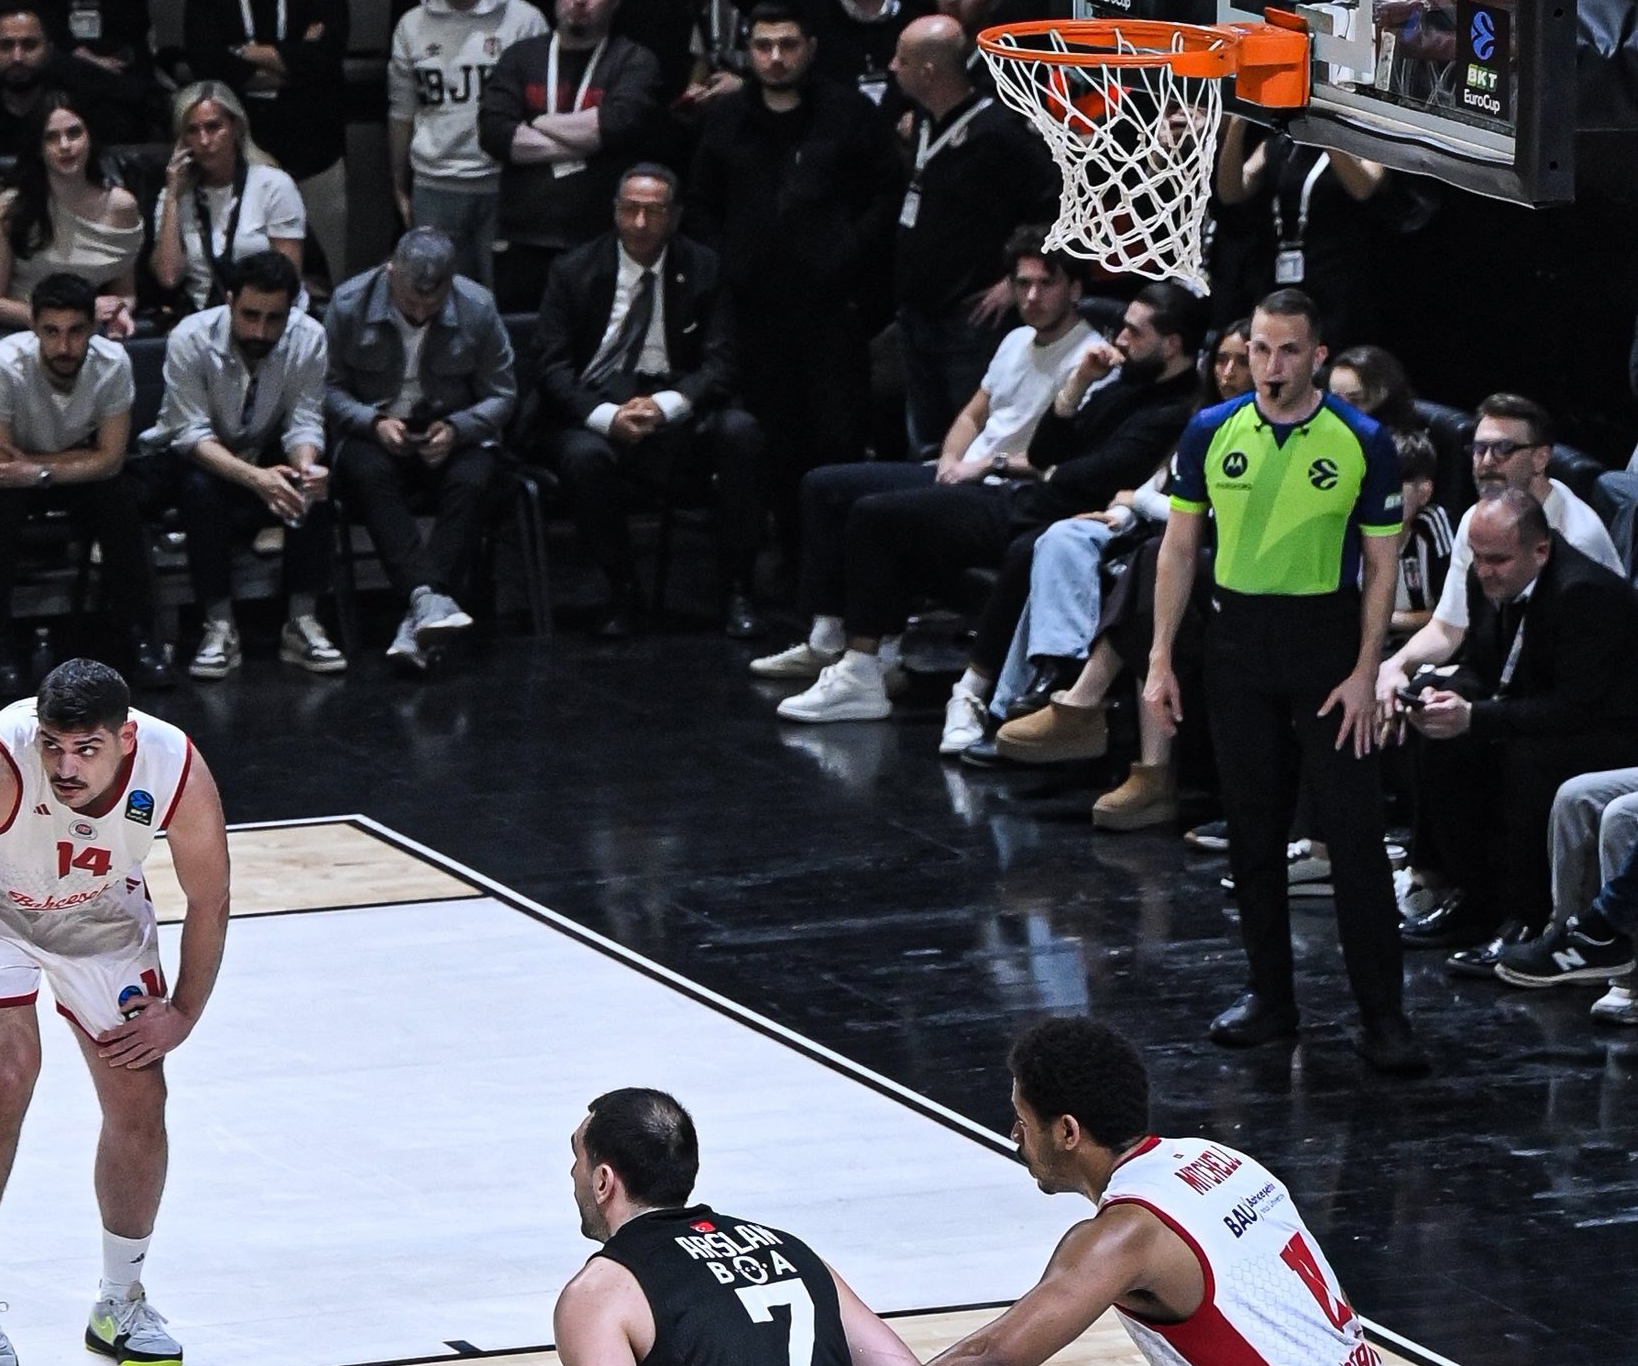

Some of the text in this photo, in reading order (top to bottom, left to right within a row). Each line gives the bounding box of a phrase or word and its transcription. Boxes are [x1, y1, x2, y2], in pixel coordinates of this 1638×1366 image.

[1466, 63, 1498, 92] BKT
[1463, 88, 1501, 115] EuroCup
[55, 841, 113, 880] 14
